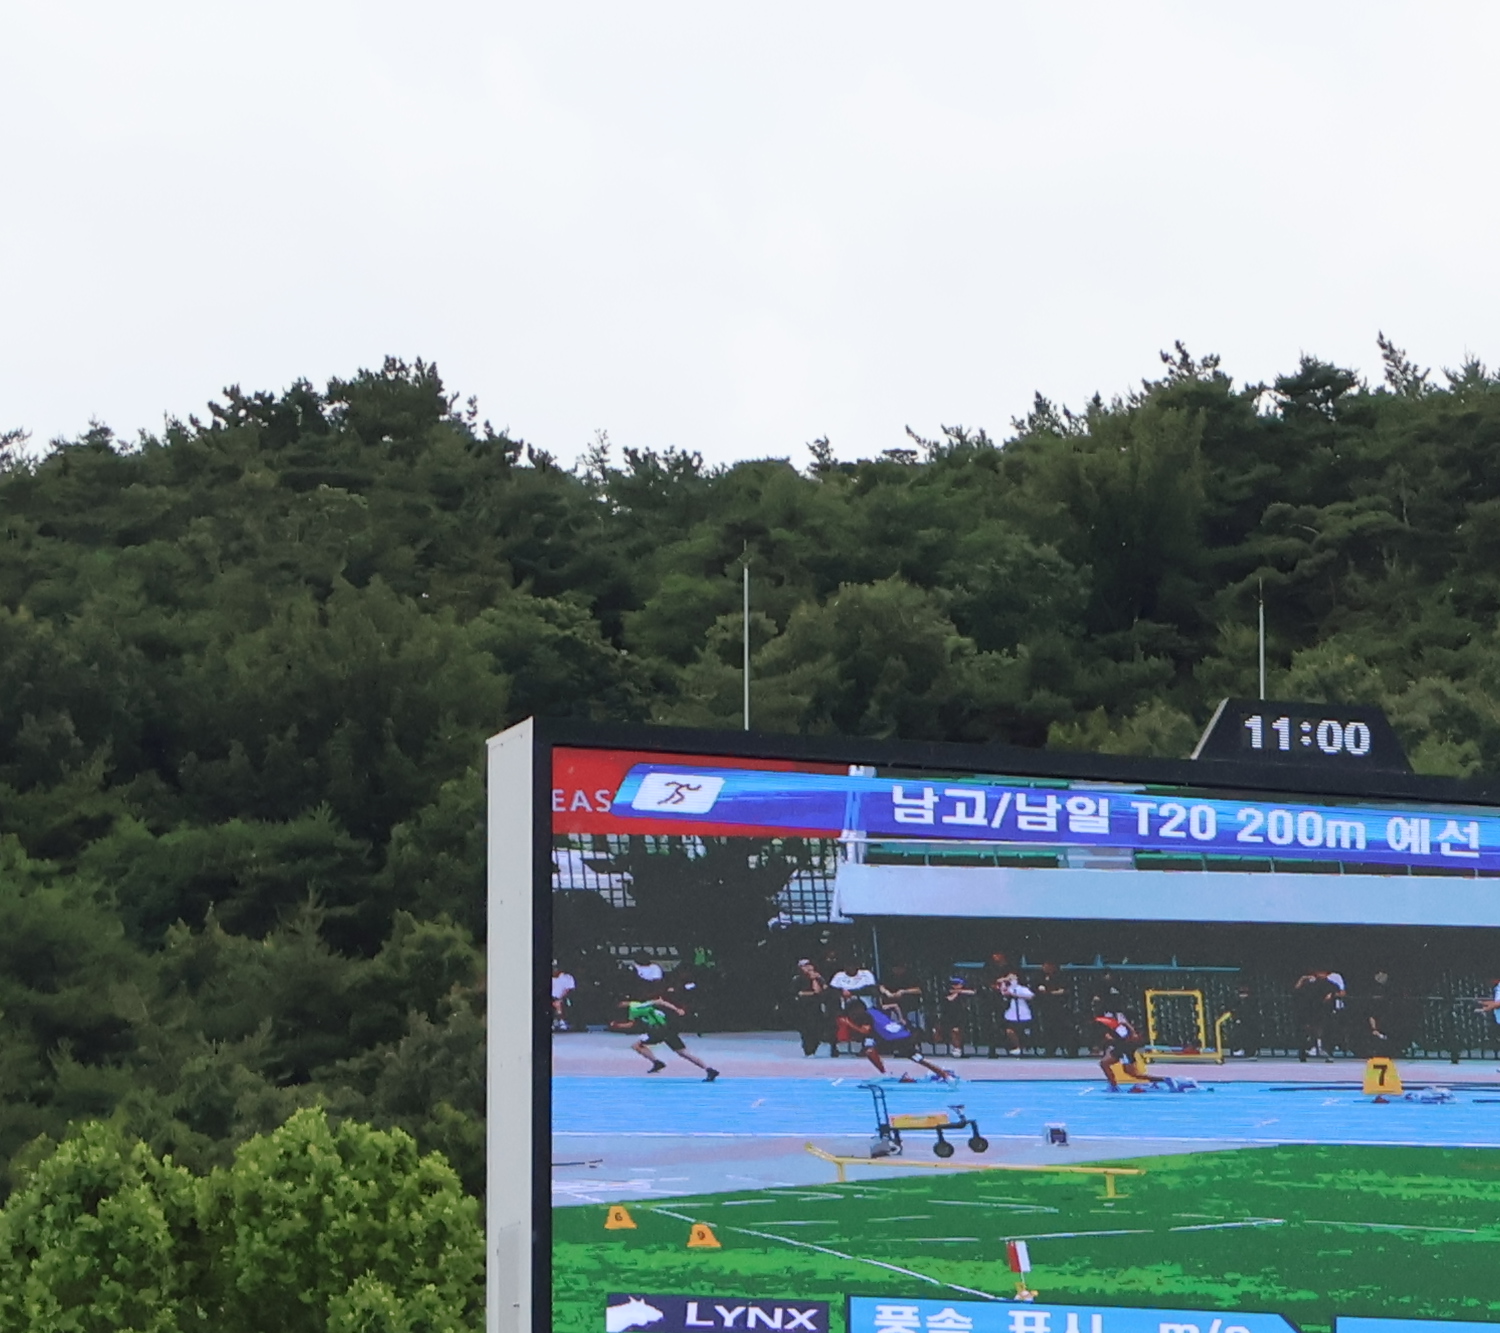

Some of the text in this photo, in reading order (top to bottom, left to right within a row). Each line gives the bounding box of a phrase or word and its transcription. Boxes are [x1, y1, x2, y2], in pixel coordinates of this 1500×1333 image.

[1244, 715, 1371, 755] 11:00
[891, 785, 1110, 834] 남고/남일
[1130, 801, 1217, 840] T20
[1236, 808, 1367, 850] 200m
[1386, 816, 1481, 858] 예선
[1373, 1065, 1388, 1086] 7
[685, 1302, 819, 1331] LYNX
